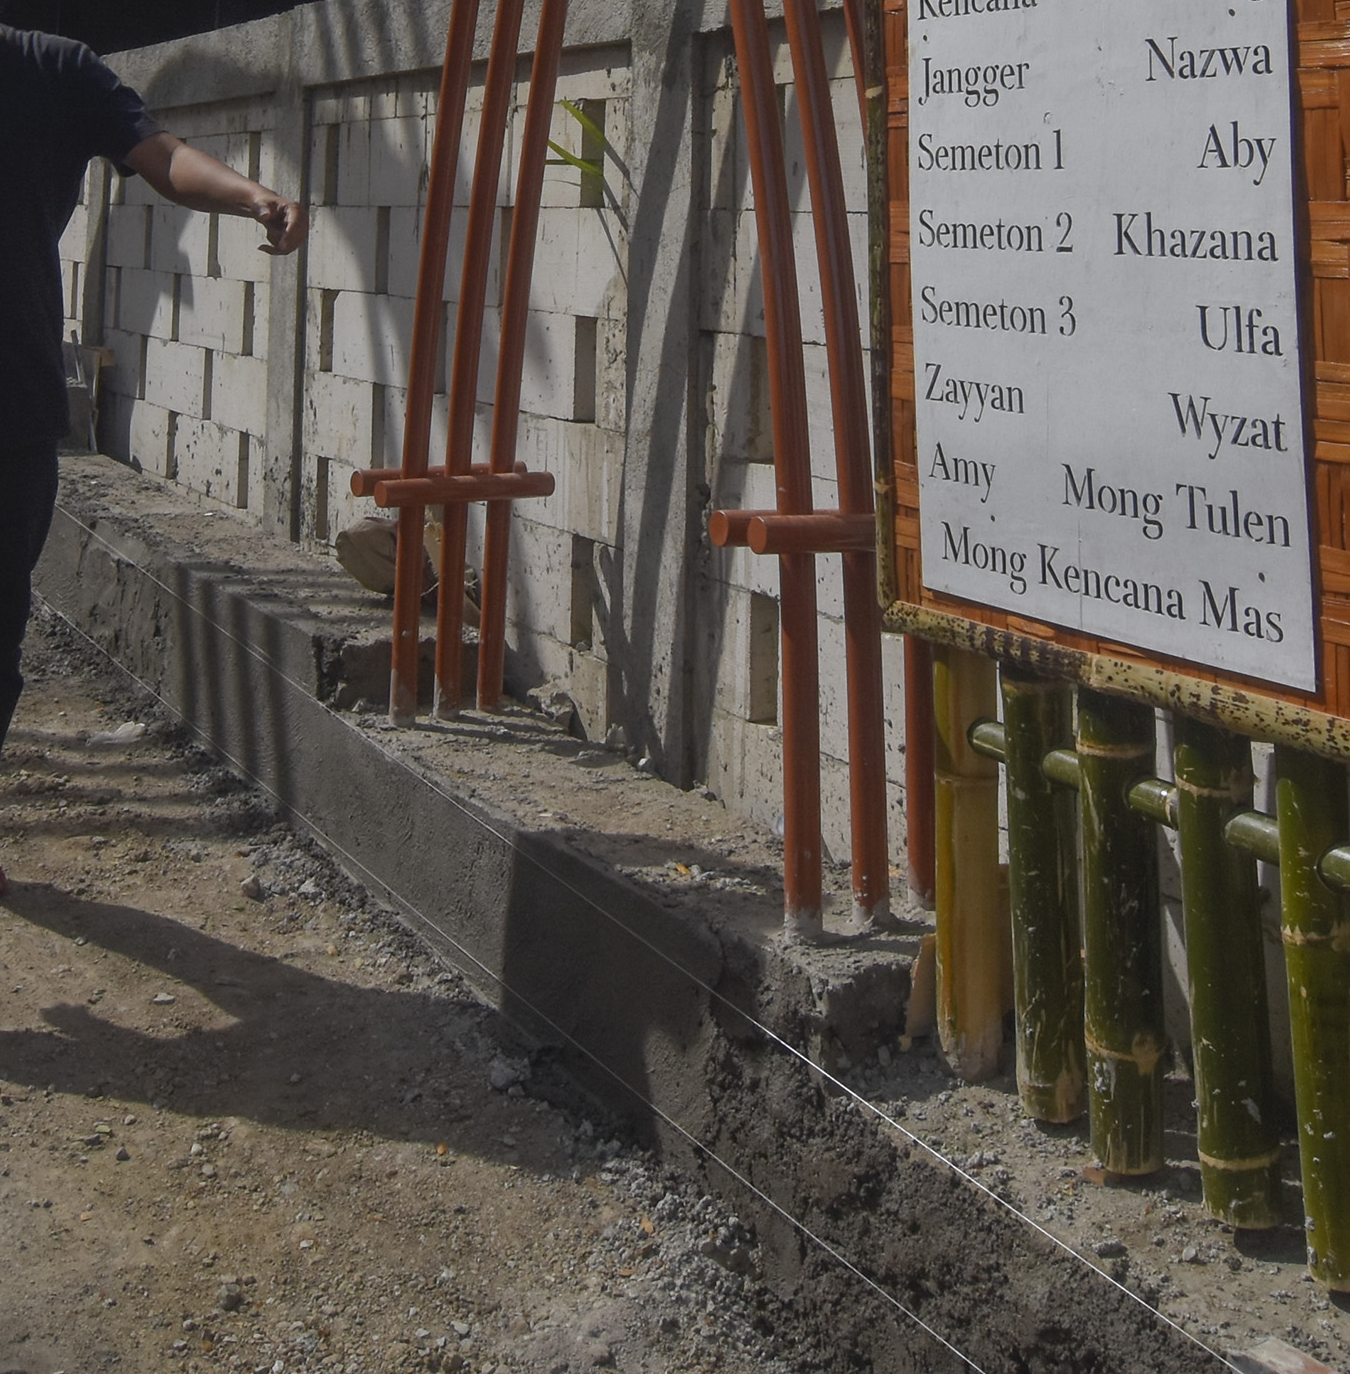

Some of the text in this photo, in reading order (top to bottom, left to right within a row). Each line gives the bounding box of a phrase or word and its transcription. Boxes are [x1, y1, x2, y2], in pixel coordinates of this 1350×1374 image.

[919, 56, 1030, 107] Jangger
[1145, 36, 1273, 82] Nazwa
[917, 130, 1065, 172] Semeton 1
[1197, 124, 1277, 186] Aby
[917, 209, 1074, 254] Semeton 2
[1112, 212, 1279, 262] Khazana
[920, 286, 1076, 336] Semeton 3
[1195, 305, 1283, 357] Ulfa
[923, 364, 1025, 422] Zayyan
[1169, 392, 1289, 460] Wyzat
[928, 441, 996, 505] Amy
[1062, 464, 1292, 547] Mong Tulen
[941, 521, 1284, 644] Mong Kencana Mas
